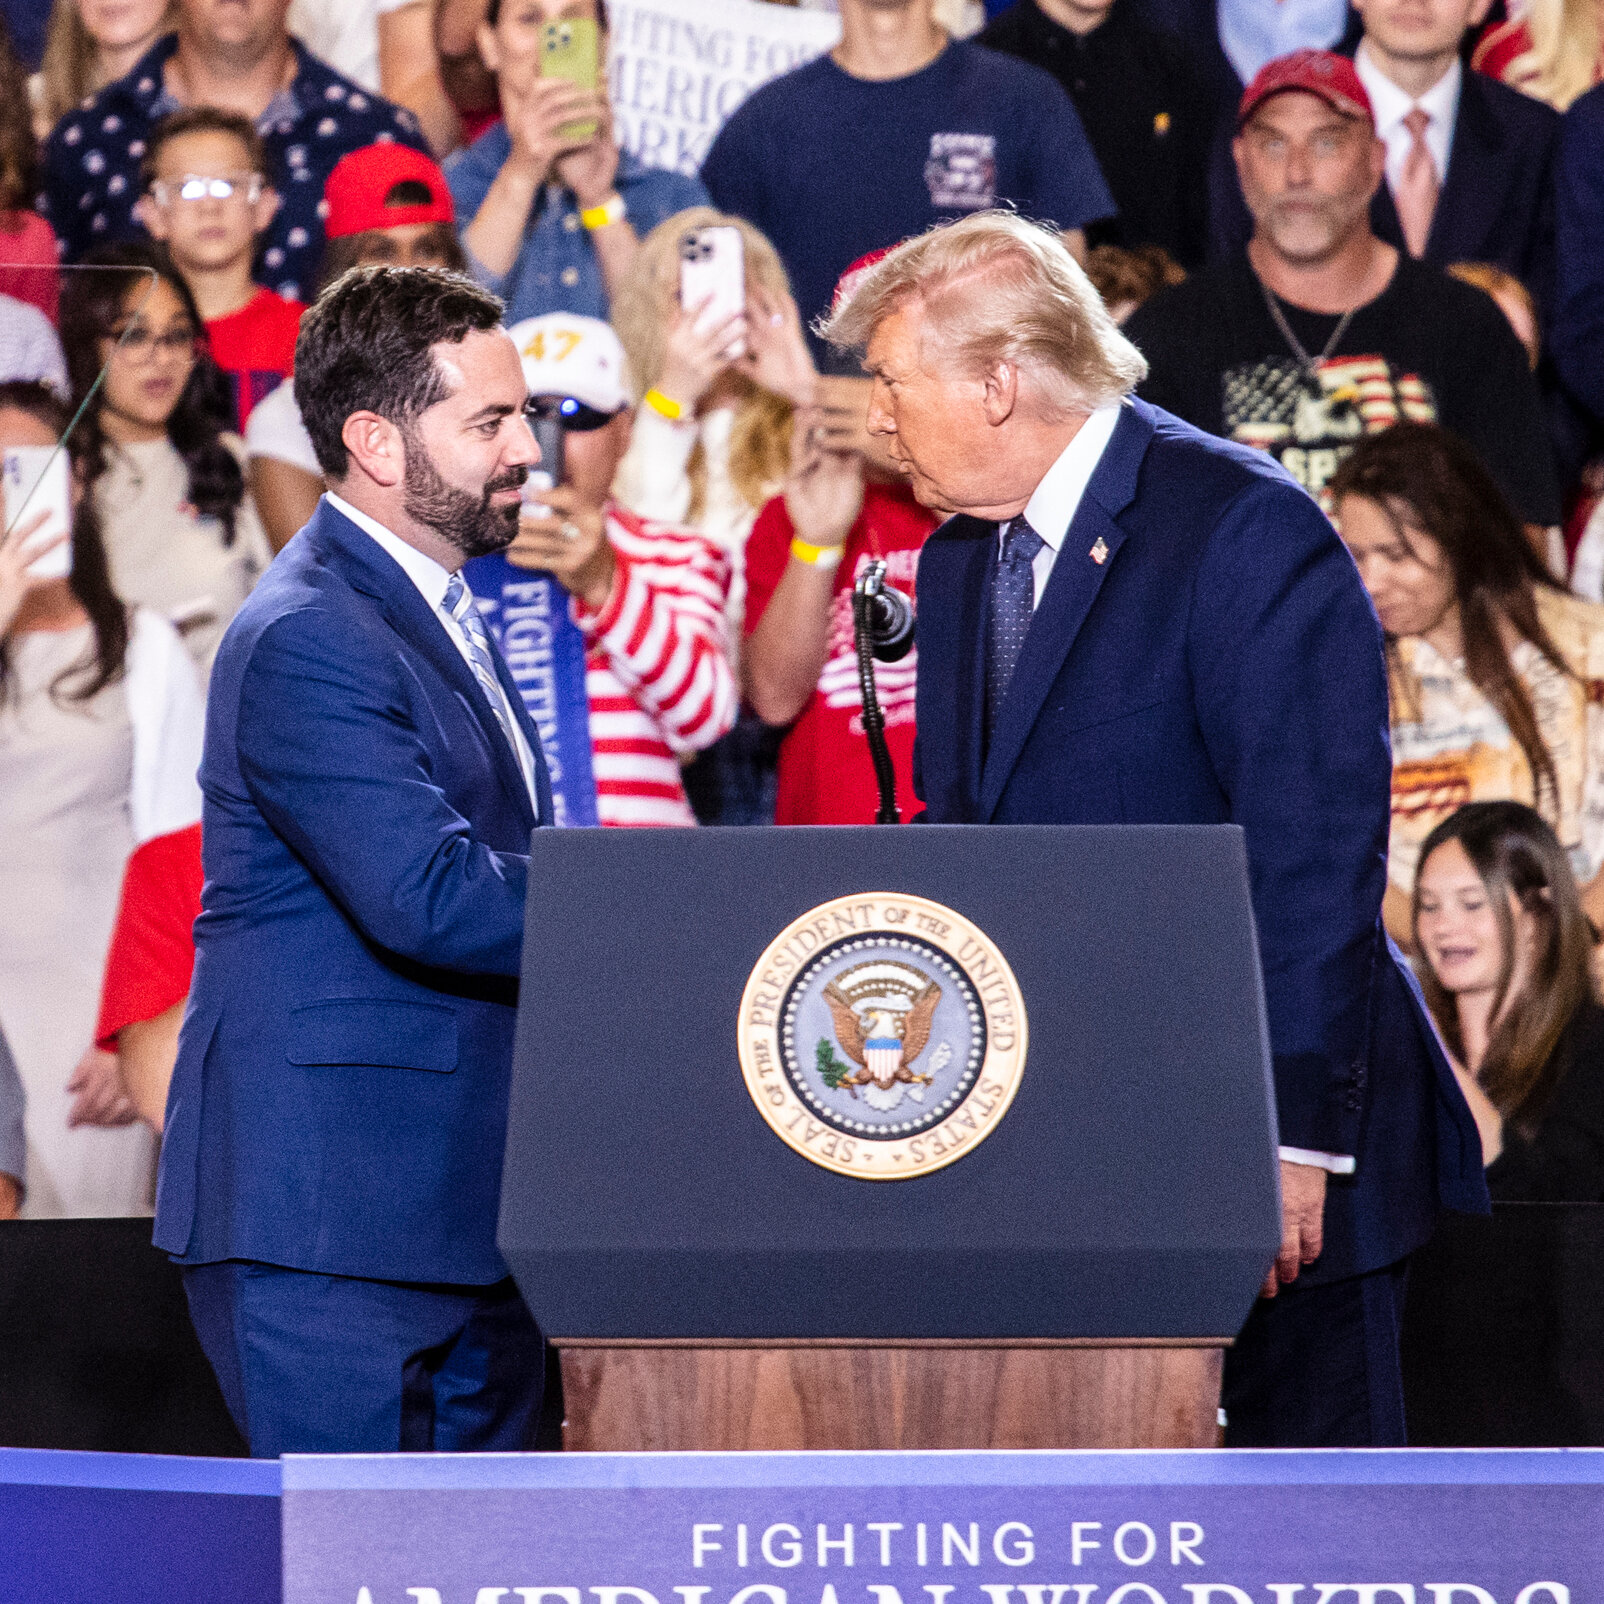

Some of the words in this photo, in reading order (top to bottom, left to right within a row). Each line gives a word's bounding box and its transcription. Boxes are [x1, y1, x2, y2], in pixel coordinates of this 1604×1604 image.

[522, 328, 584, 362] 47
[884, 906, 909, 924] OF
[915, 912, 952, 941] THE
[750, 904, 875, 1027] PRESIDENT
[956, 936, 1015, 1052] UNITED
[753, 1038, 774, 1078] THE
[764, 1083, 785, 1107] OF
[786, 1108, 857, 1163] SEAL
[907, 1076, 1004, 1164] STATES
[692, 1522, 1036, 1569] FIGHTING
[1071, 1521, 1206, 1567] FOR
